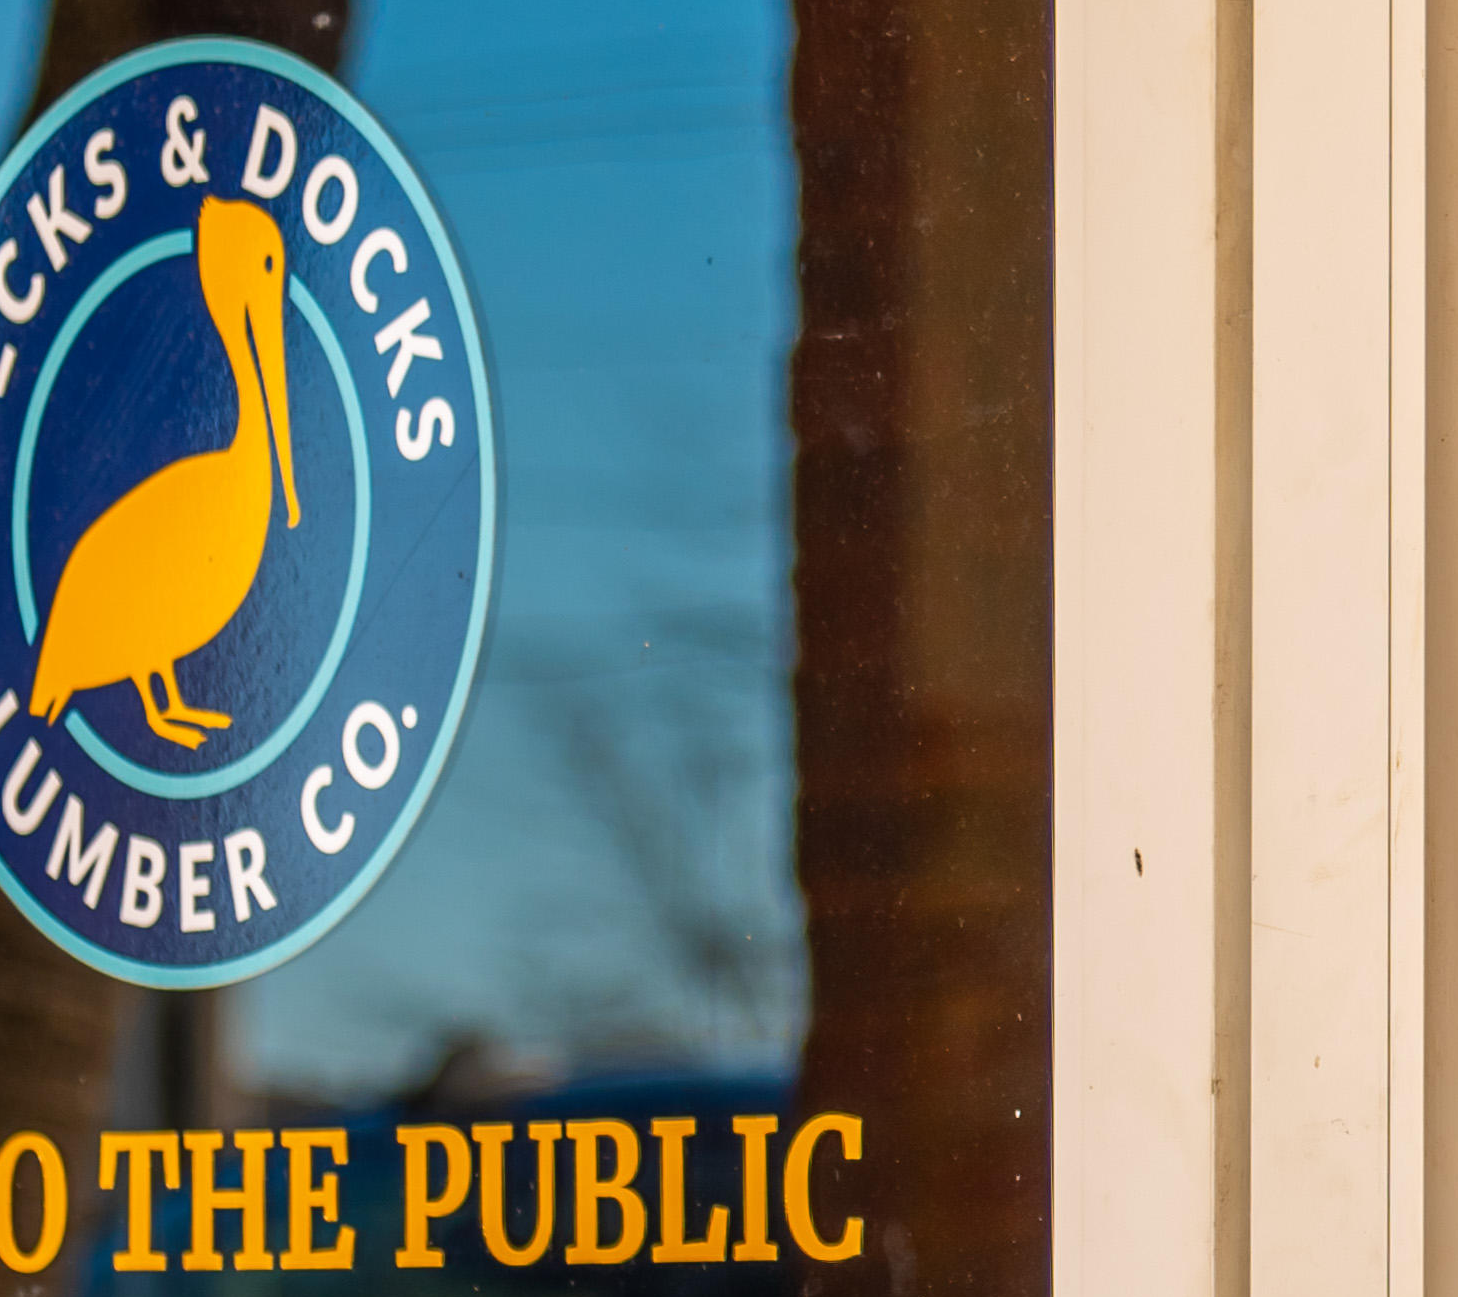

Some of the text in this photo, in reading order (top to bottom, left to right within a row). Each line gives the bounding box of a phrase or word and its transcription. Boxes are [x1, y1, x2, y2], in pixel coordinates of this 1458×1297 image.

[159, 94, 210, 187] &
[241, 102, 456, 463] DOCKS
[299, 700, 418, 857] CO.
[97, 1128, 356, 1273] THE
[394, 1113, 865, 1270] PUBLIC
